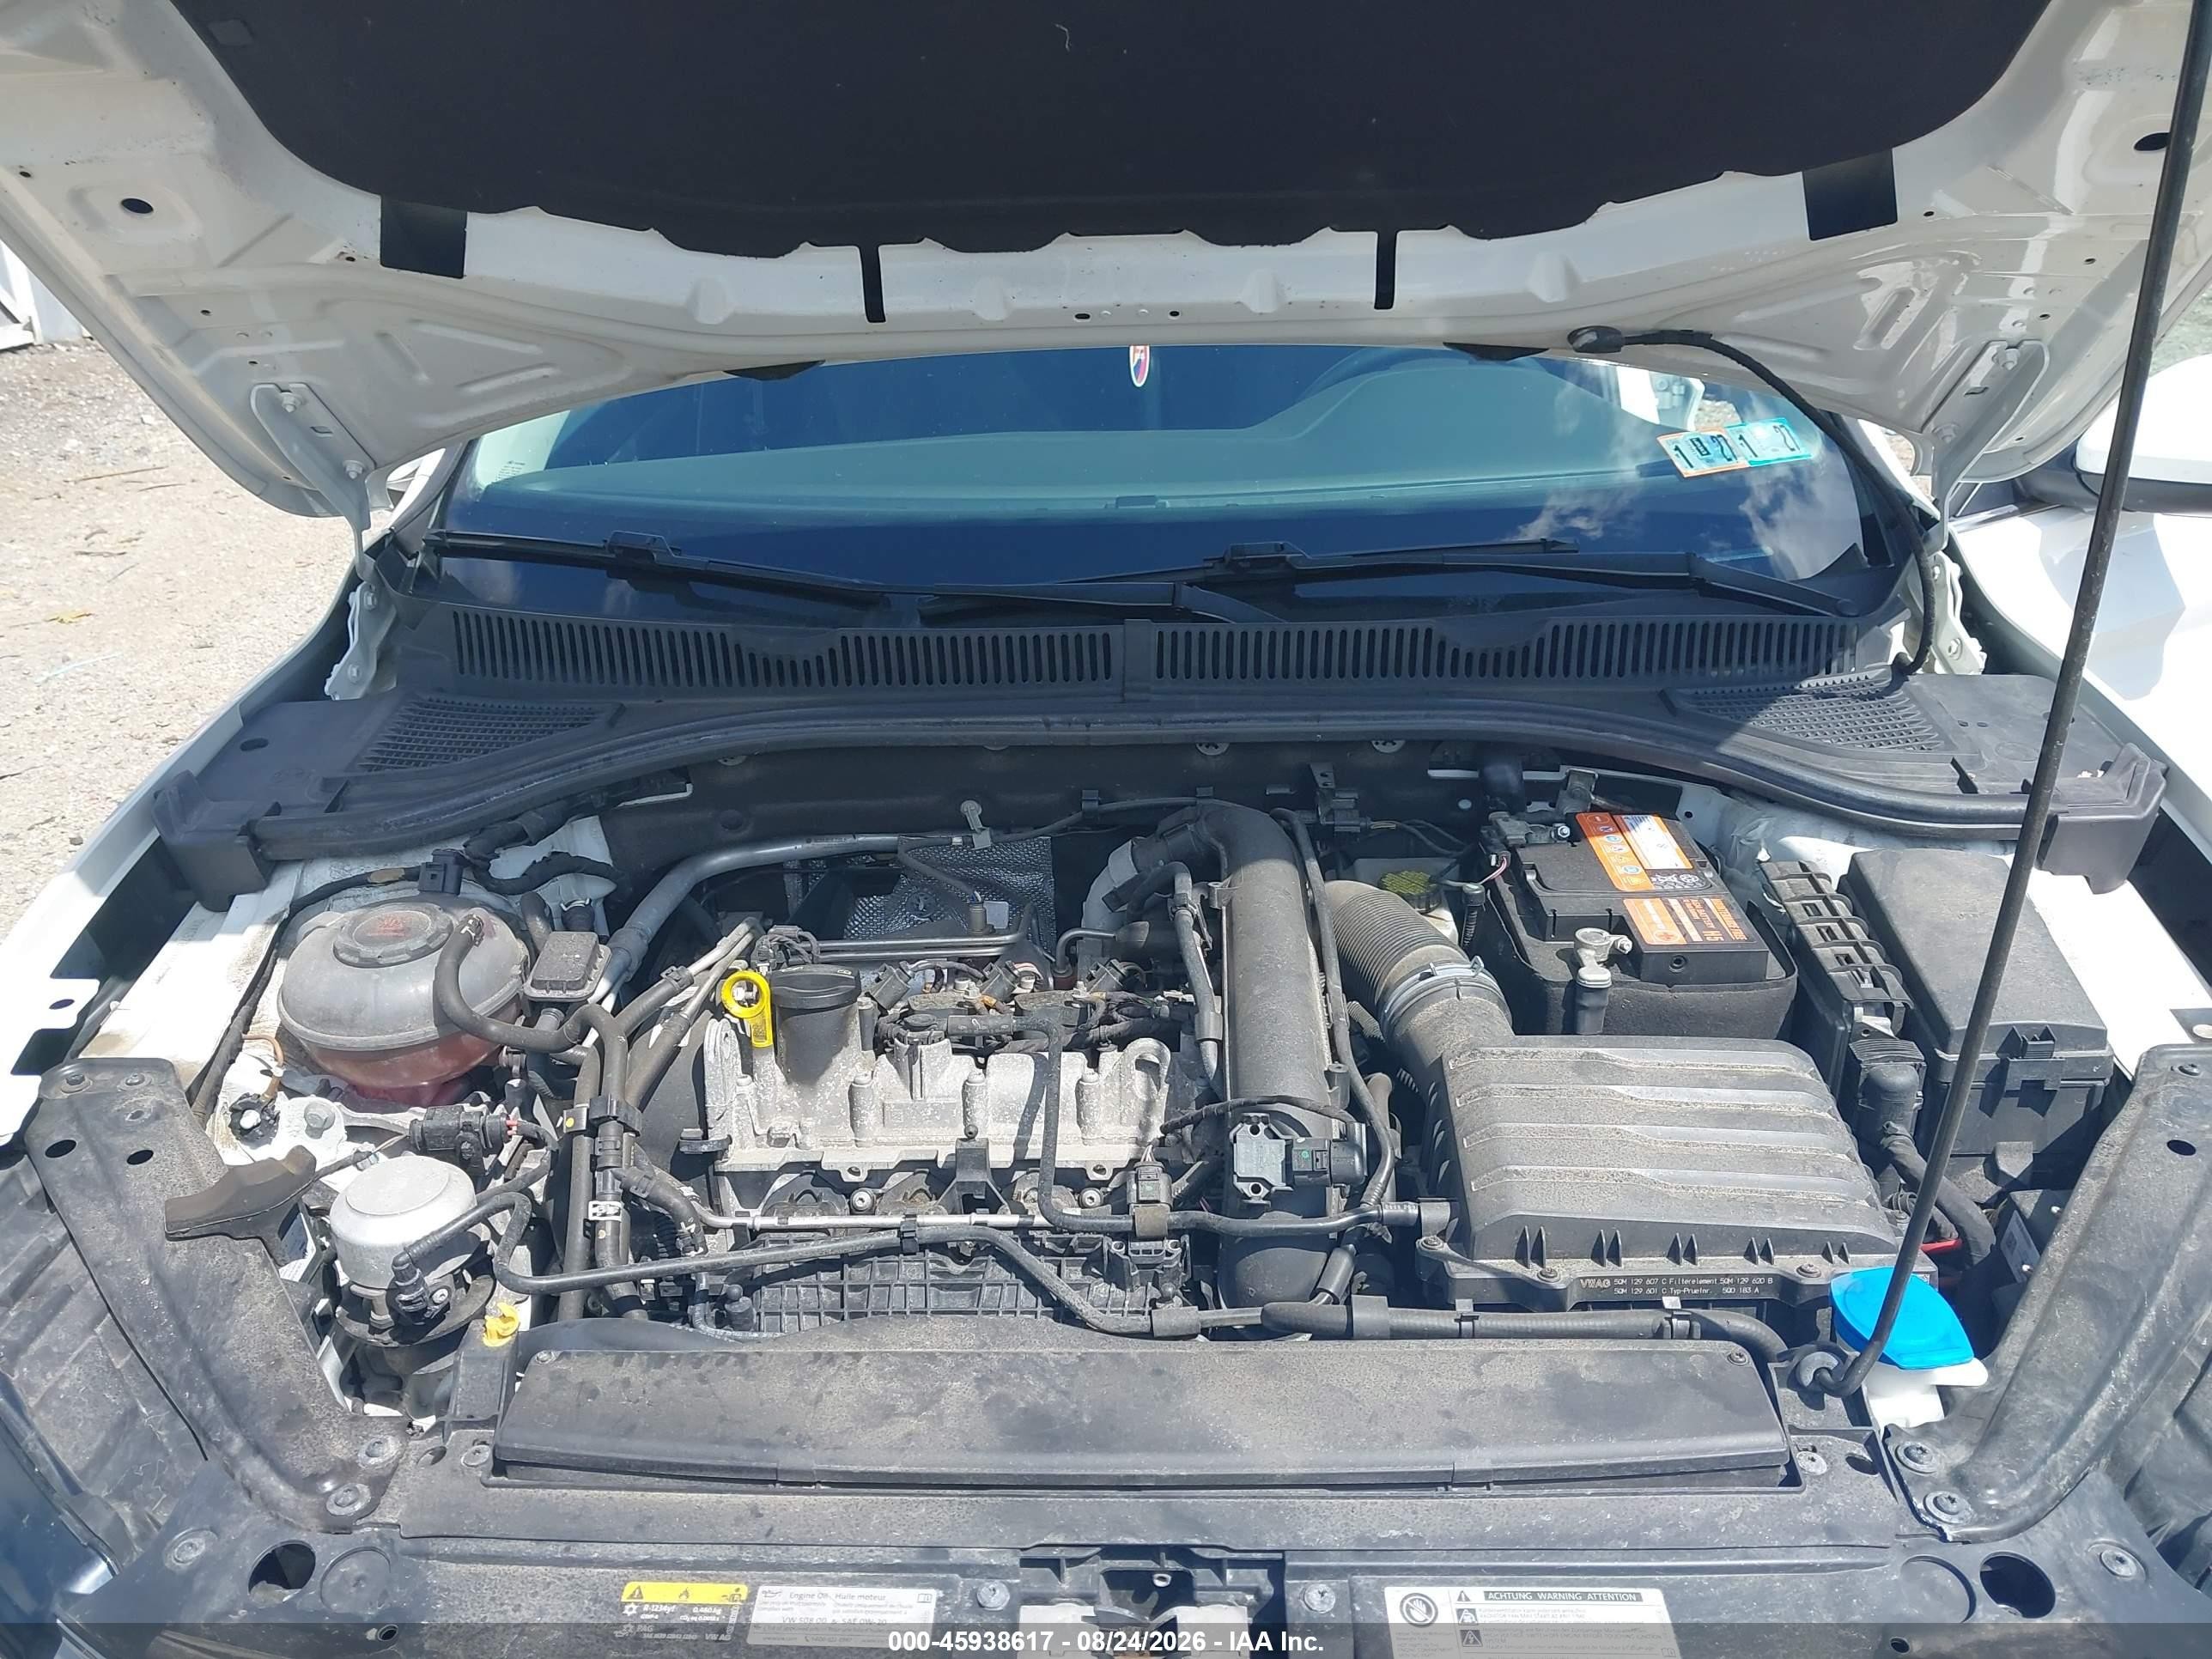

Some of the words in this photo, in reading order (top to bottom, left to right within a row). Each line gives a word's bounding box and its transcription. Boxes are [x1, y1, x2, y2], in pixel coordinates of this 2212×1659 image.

[1674, 445, 1694, 469] 1
[1739, 434, 1758, 458] 1
[1537, 1592, 1582, 1601] WARNING
[1586, 1593, 1637, 1601] ATTENTION
